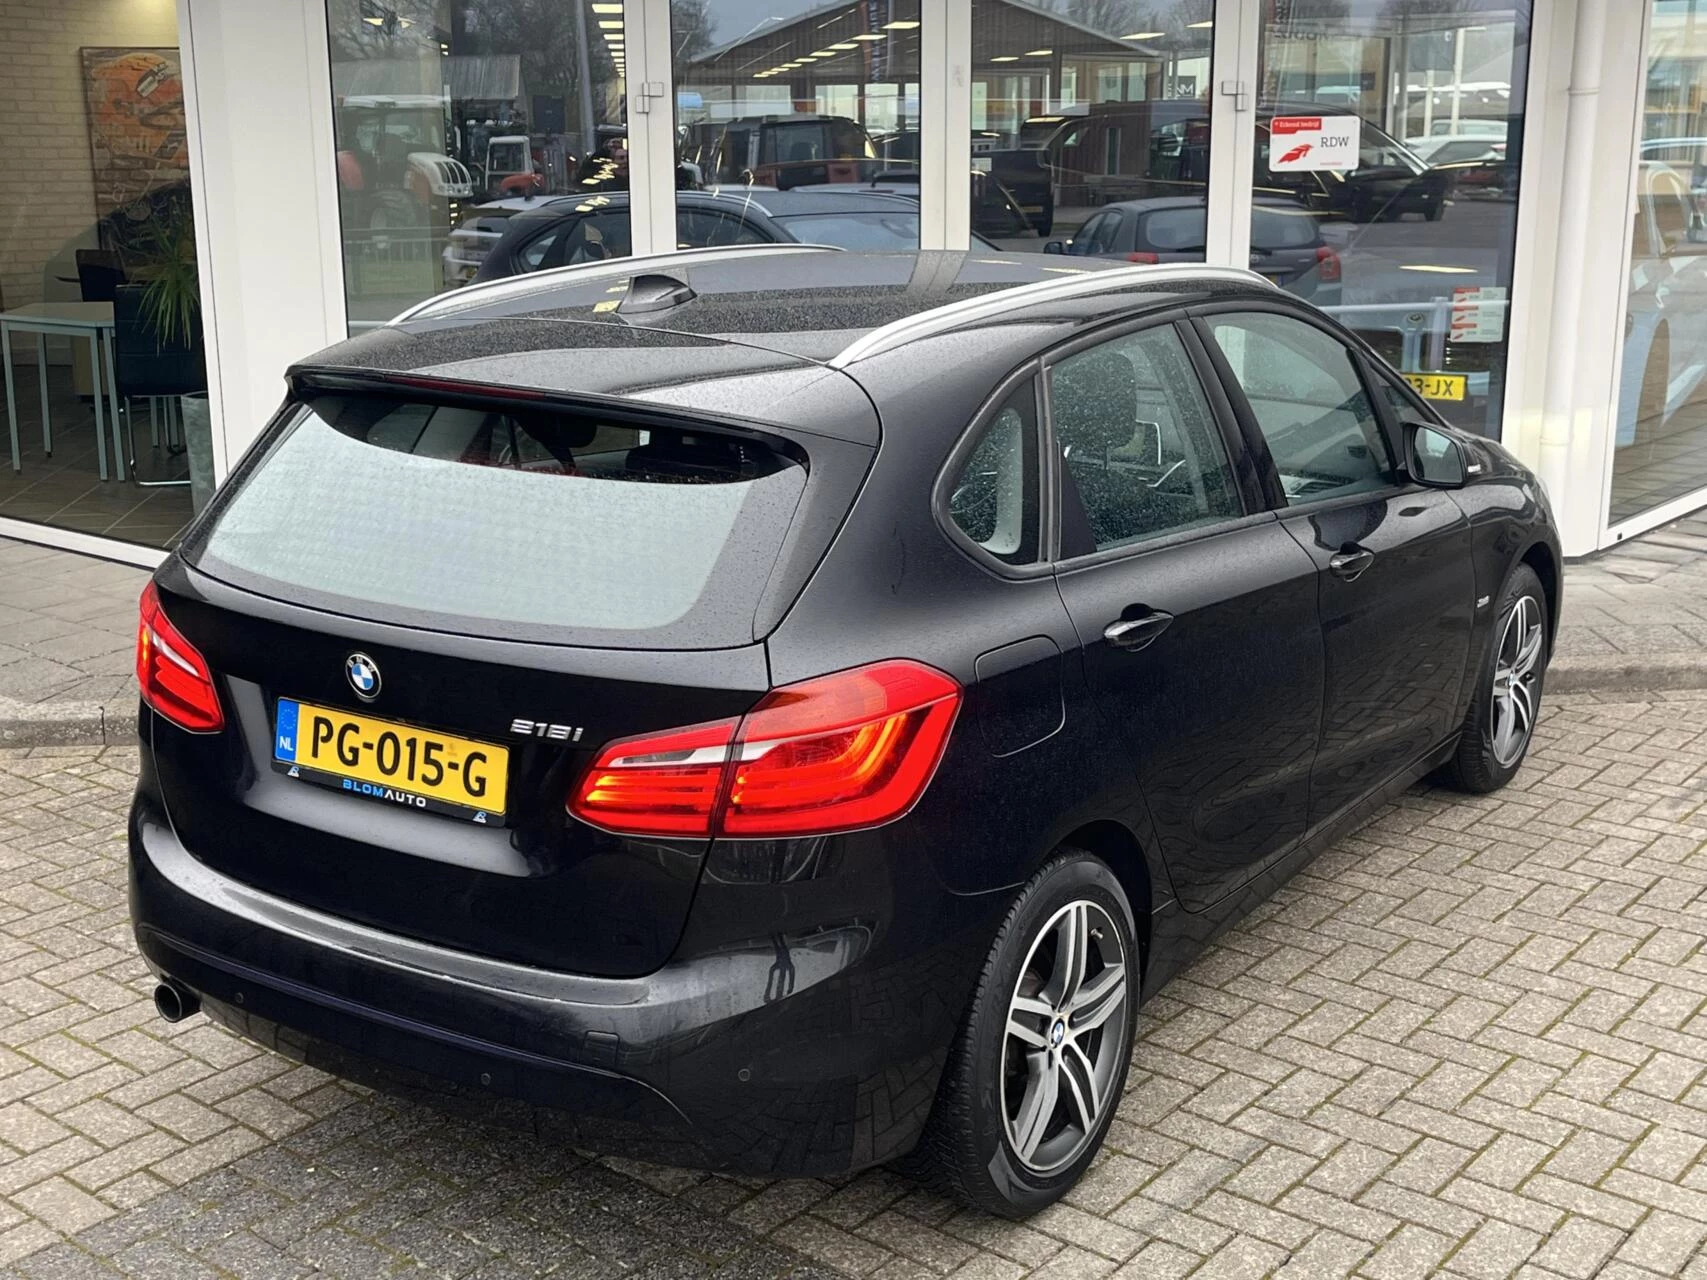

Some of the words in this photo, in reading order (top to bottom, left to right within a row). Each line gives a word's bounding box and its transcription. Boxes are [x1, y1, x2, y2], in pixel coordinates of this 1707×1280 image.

[1320, 136, 1349, 148] RDW
[1404, 378, 1454, 396] 3-JX
[510, 719, 584, 742] 218i
[279, 736, 294, 751] NL
[312, 715, 487, 797] PG-015-G
